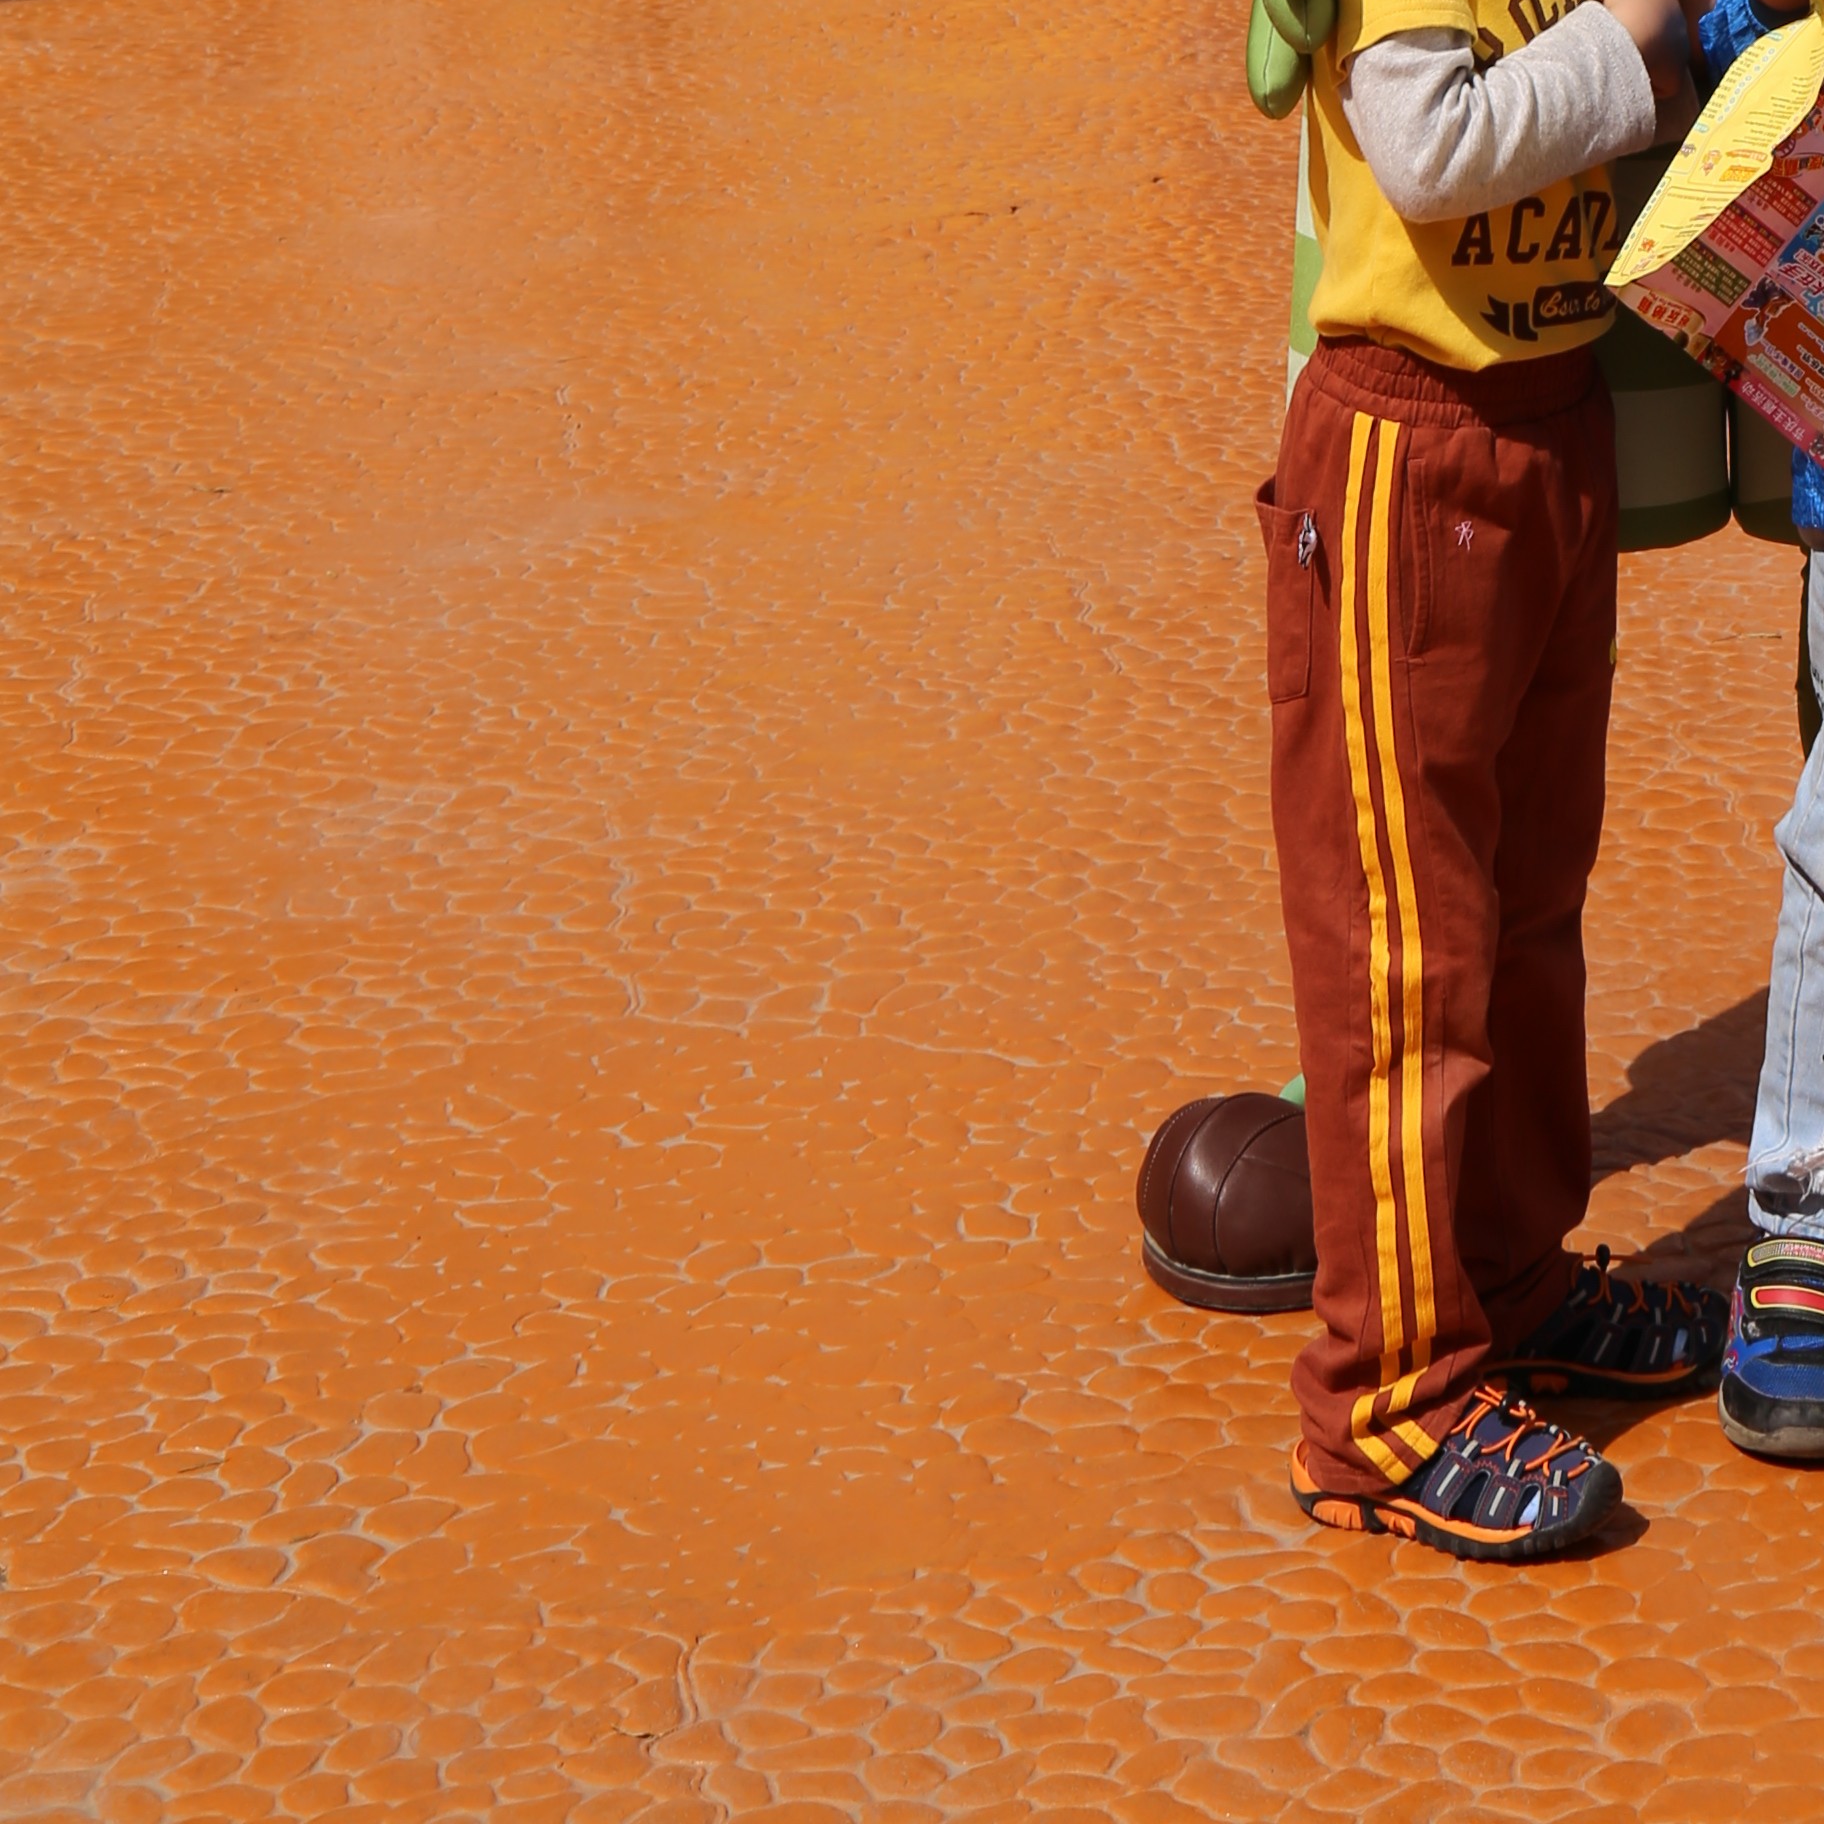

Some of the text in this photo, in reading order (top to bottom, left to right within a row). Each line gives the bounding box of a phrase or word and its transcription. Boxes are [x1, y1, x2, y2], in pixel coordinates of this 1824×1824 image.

[1451, 190, 1622, 266] ACAD
[1739, 380, 1808, 441] 节庆主题活动
